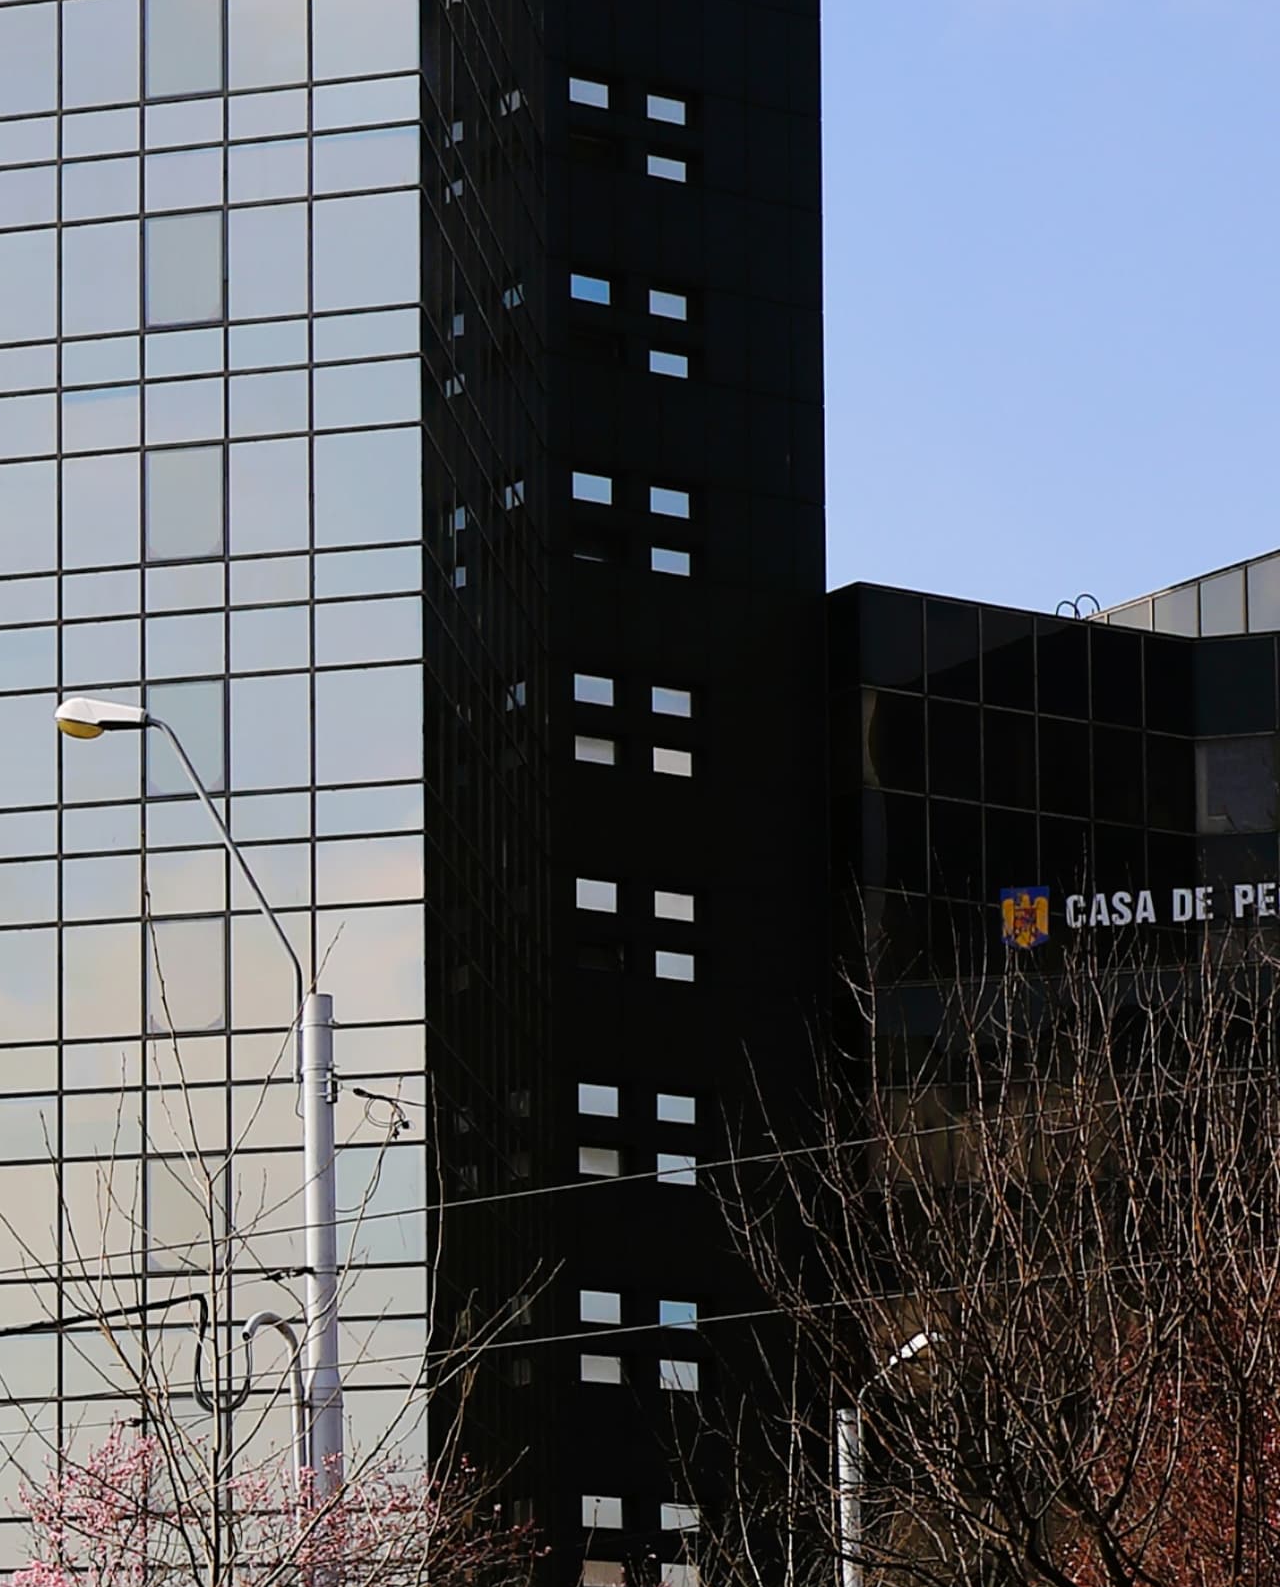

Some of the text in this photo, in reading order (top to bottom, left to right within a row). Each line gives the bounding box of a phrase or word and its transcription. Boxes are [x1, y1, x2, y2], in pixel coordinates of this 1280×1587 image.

[1065, 882, 1280, 929] CASA DE PE
